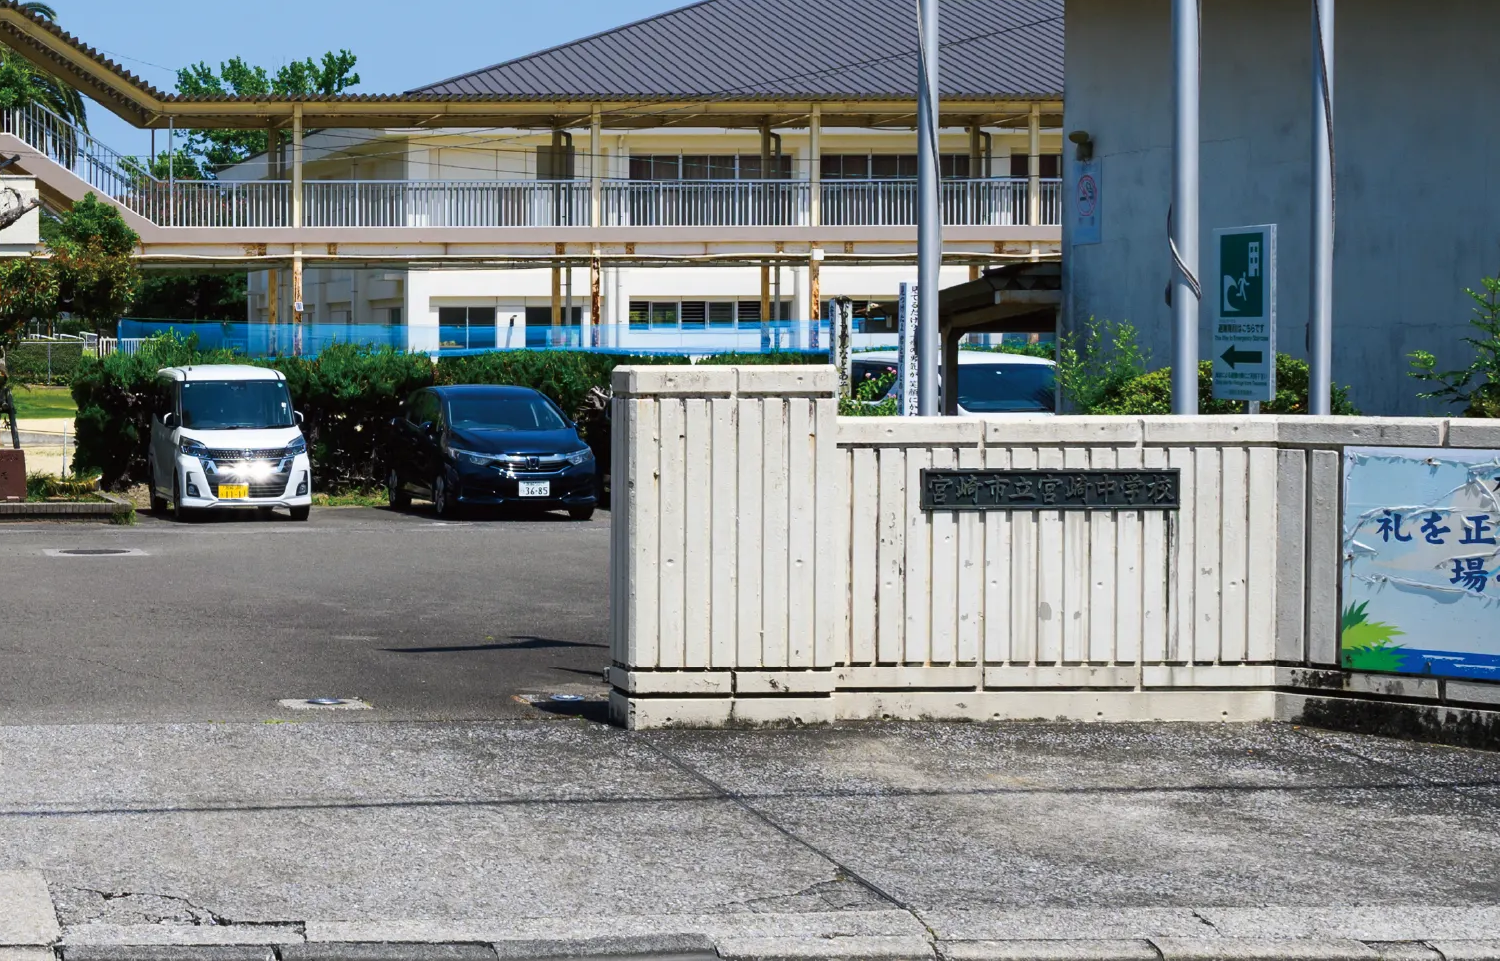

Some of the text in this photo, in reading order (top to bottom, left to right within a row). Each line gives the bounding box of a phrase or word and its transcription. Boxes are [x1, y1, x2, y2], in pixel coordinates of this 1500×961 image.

[928, 473, 1175, 505] 宮崎市立宮崎中学校
[1376, 510, 1497, 545] 礼を正
[1449, 558, 1500, 593] 場
